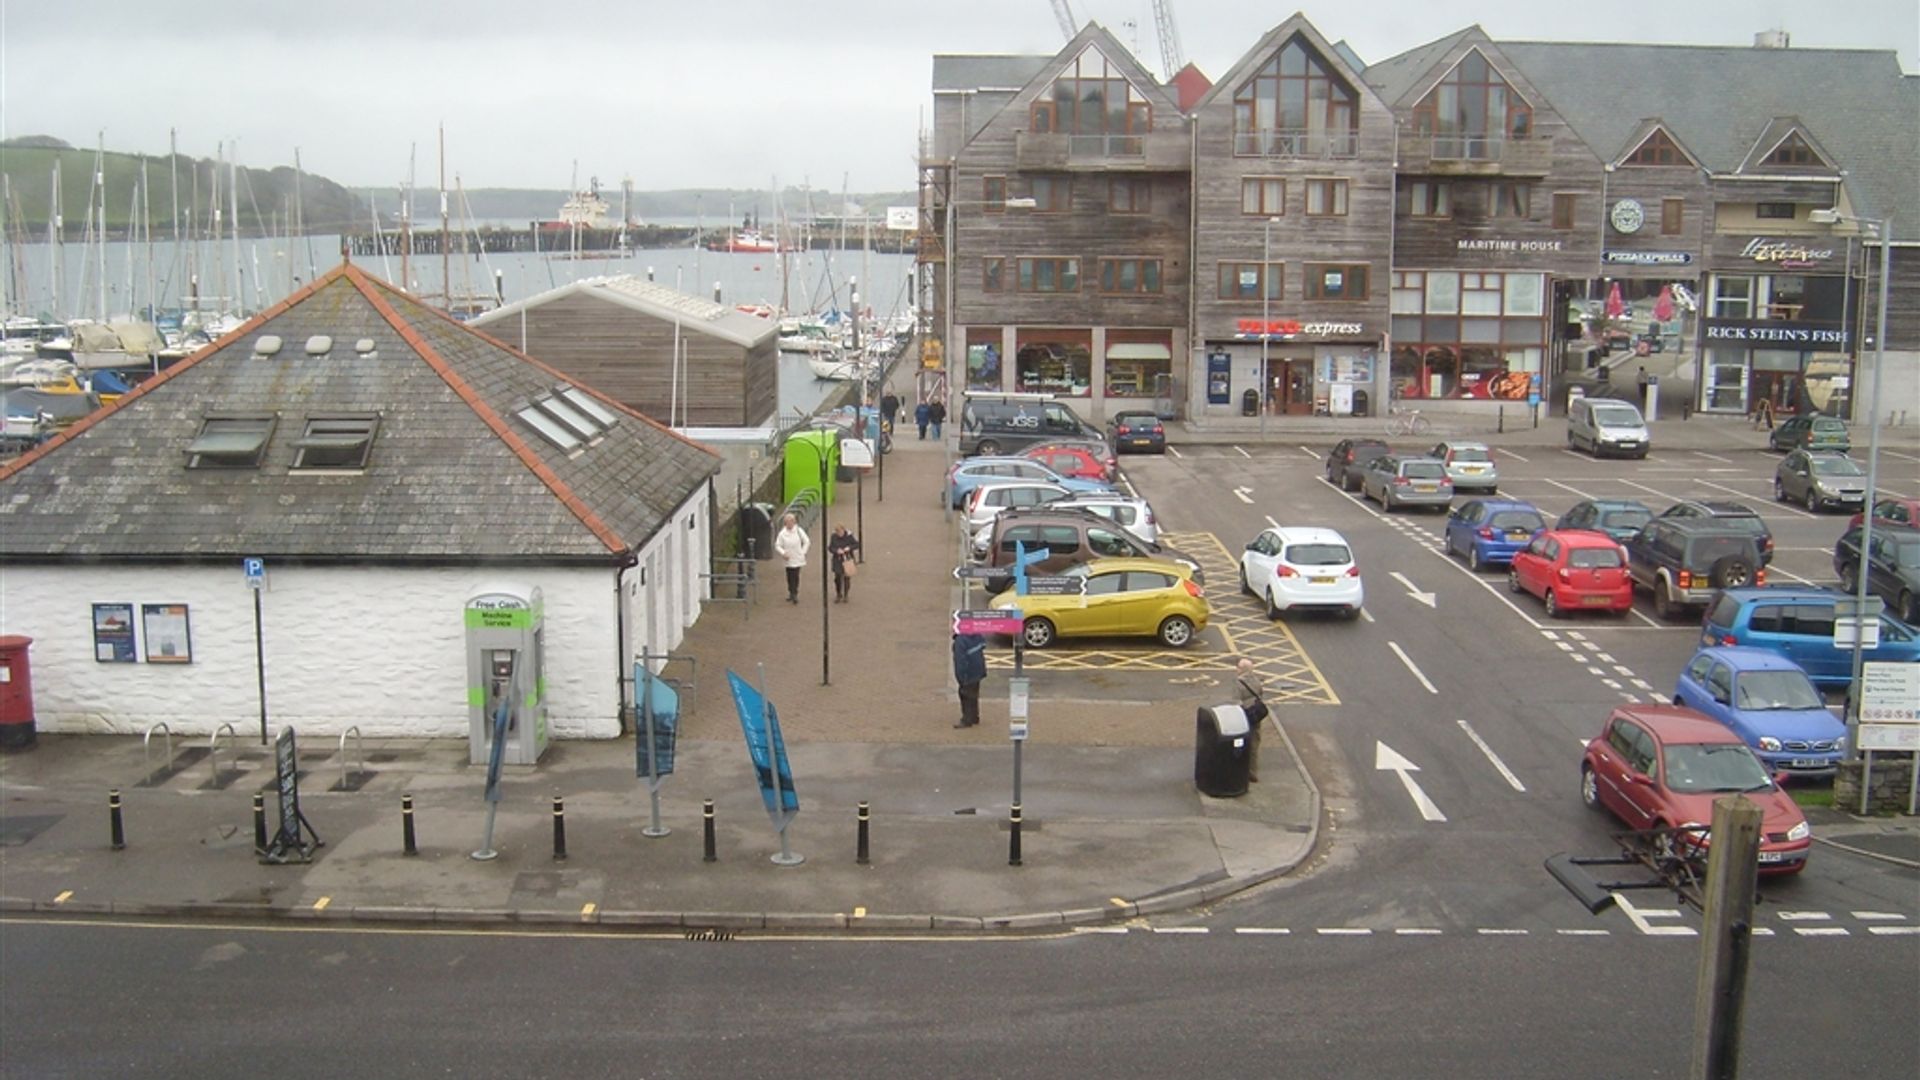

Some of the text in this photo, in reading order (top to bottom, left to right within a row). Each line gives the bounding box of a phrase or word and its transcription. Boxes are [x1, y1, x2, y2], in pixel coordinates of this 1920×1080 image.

[1457, 239, 1561, 251] MARITIME HOUSE
[1304, 322, 1362, 336] express
[1707, 326, 1848, 342] RICK STEIN'S FISH
[249, 560, 261, 575] P
[476, 600, 521, 609] Free Cash
[482, 611, 512, 619] Machine
[484, 619, 511, 627] Service
